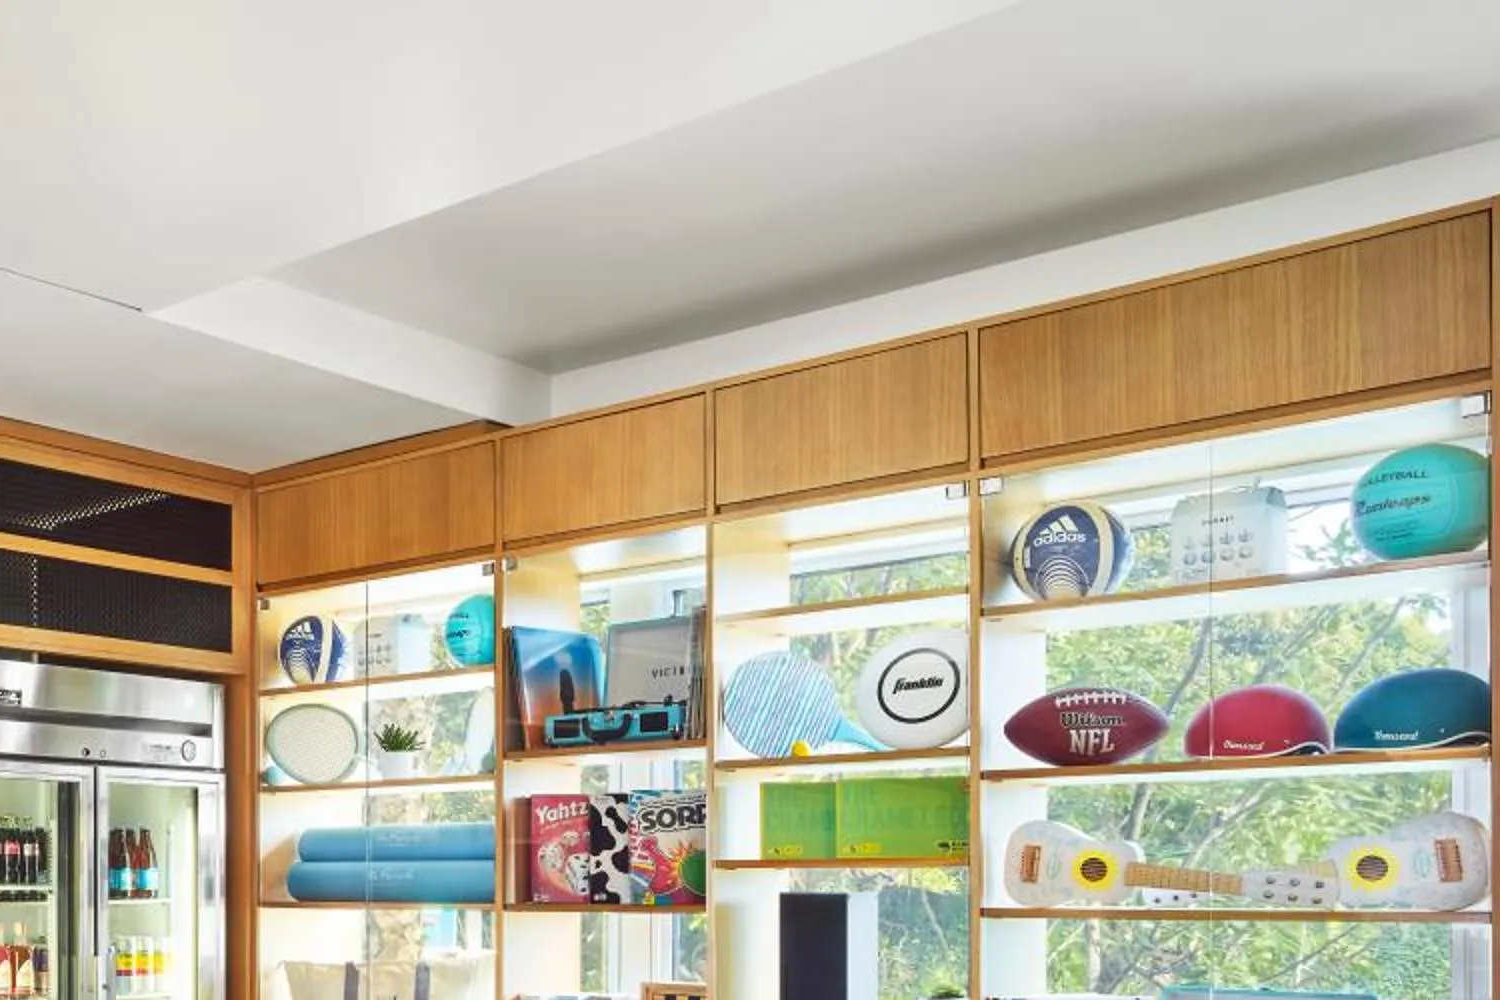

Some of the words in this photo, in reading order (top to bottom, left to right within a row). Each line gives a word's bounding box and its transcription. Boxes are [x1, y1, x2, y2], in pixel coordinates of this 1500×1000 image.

[1363, 469, 1429, 486] LLEYBALL
[1033, 531, 1087, 547] adidas
[1060, 712, 1125, 729] Wilson
[1069, 728, 1115, 757] NFL
[535, 801, 589, 825] Yahtz
